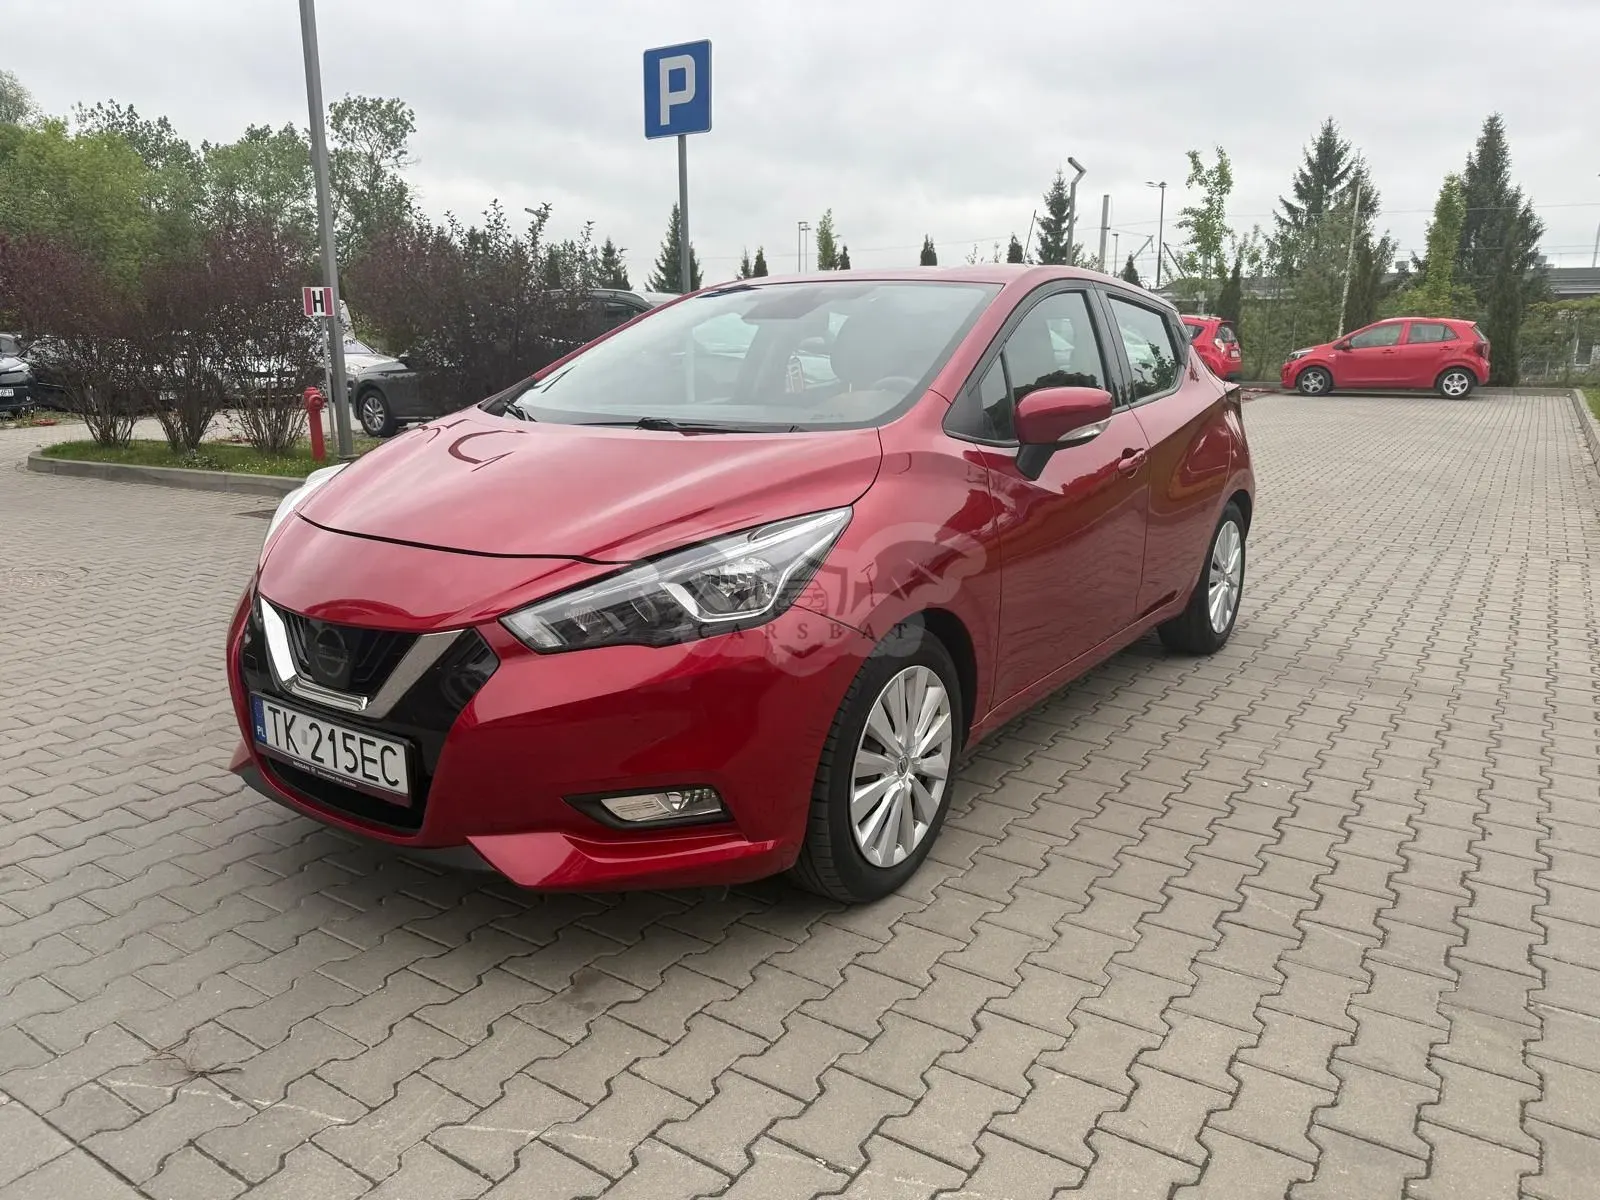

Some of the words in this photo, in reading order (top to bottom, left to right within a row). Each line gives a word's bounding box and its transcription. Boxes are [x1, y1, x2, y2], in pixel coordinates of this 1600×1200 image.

[659, 54, 695, 125] P
[312, 291, 325, 312] H
[257, 725, 266, 738] PL
[267, 705, 300, 755] TK
[308, 722, 400, 787] 215EC
